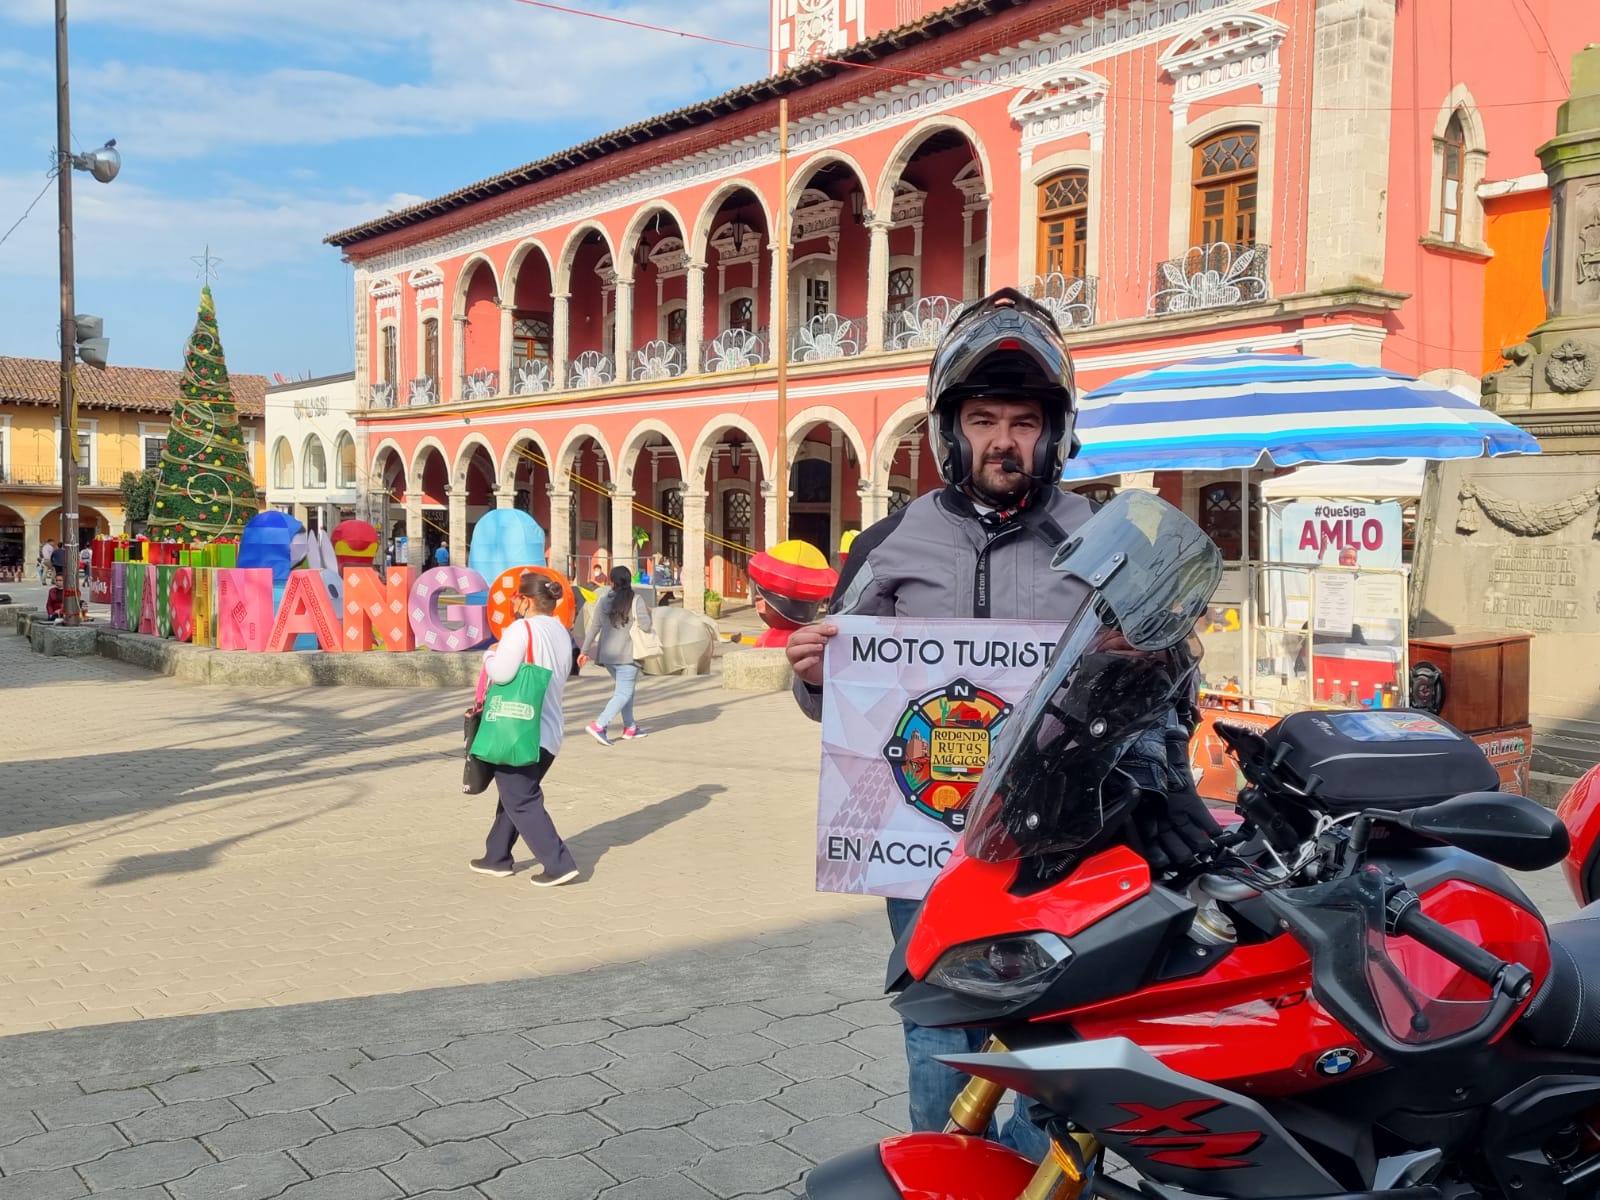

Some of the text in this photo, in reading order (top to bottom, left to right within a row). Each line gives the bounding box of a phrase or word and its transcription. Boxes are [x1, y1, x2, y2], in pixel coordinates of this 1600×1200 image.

[1314, 505, 1367, 518] #QueSiga
[1298, 518, 1384, 551] AMLO
[852, 636, 1057, 667] MOTO TURIST
[954, 685, 969, 696] N
[889, 746, 902, 757] O
[951, 814, 965, 825] S
[828, 836, 953, 869] EN ACCIÓ
